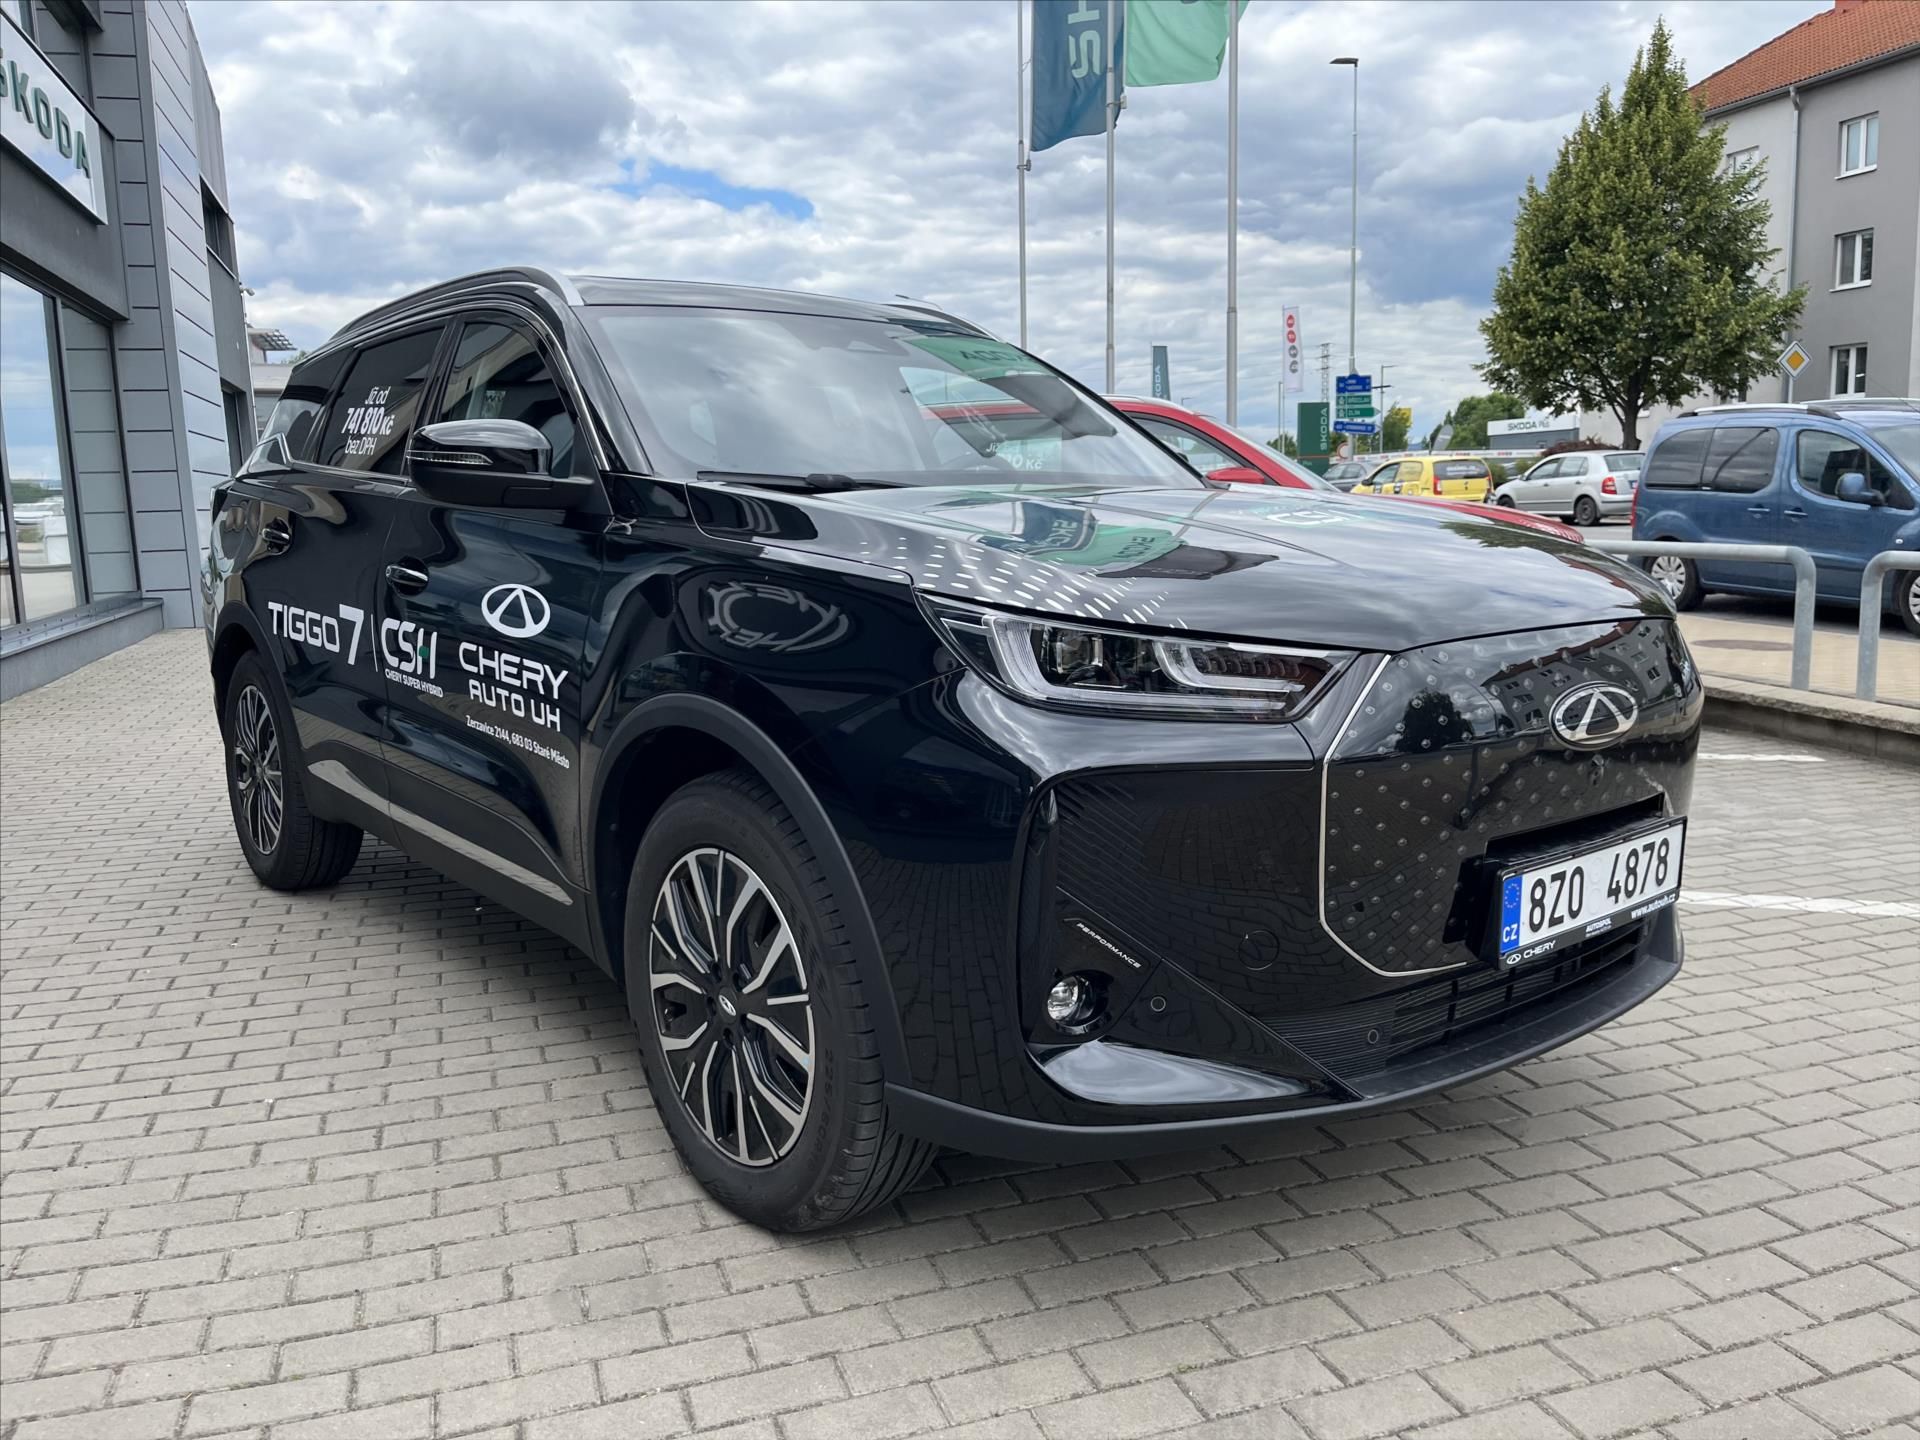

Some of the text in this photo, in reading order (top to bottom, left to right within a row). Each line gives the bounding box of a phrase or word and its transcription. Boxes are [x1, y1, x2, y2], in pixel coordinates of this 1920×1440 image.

[375, 386, 392, 405] od
[341, 407, 366, 434] 741
[360, 407, 386, 435] 810
[344, 435, 378, 456] bez DPH
[267, 600, 438, 680] TIGGO 7 CSH
[384, 668, 444, 698] CHERY SUPER HYBRID
[458, 641, 569, 700] CHERY
[469, 678, 561, 733] AUTO UH
[533, 741, 551, 760] Staré
[550, 748, 570, 769] Město
[1607, 837, 1670, 904] 4878
[1076, 922, 1142, 969] PERFORMANCE
[1502, 923, 1519, 943] CZ
[1523, 939, 1557, 959] CHERY
